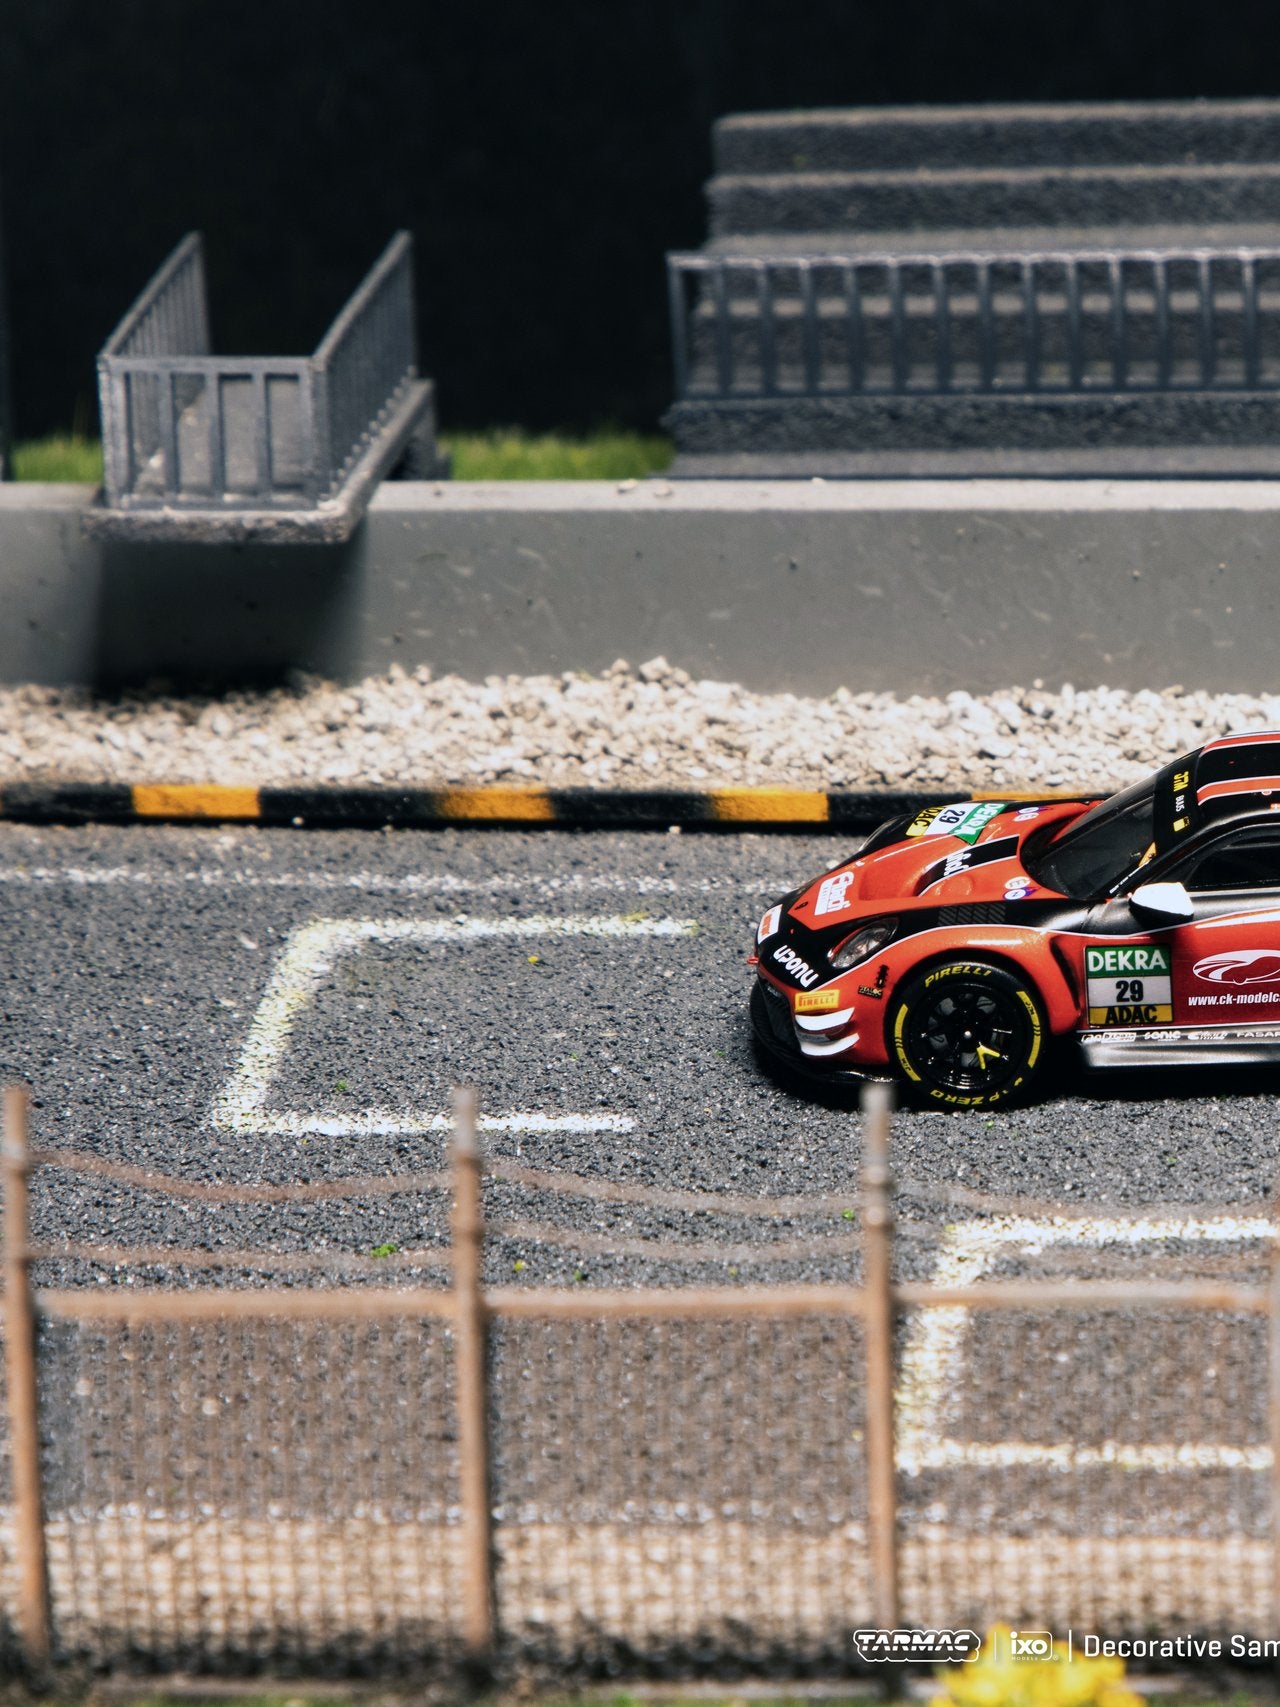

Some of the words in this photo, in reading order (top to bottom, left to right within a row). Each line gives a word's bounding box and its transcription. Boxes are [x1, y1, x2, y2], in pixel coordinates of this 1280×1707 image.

[914, 806, 946, 827] DAC
[939, 809, 966, 824] 29
[1088, 949, 1167, 972] DEKRA
[924, 965, 992, 988] PIRELLI
[1115, 980, 1144, 1003] 29
[1105, 1005, 1158, 1024] ADAC
